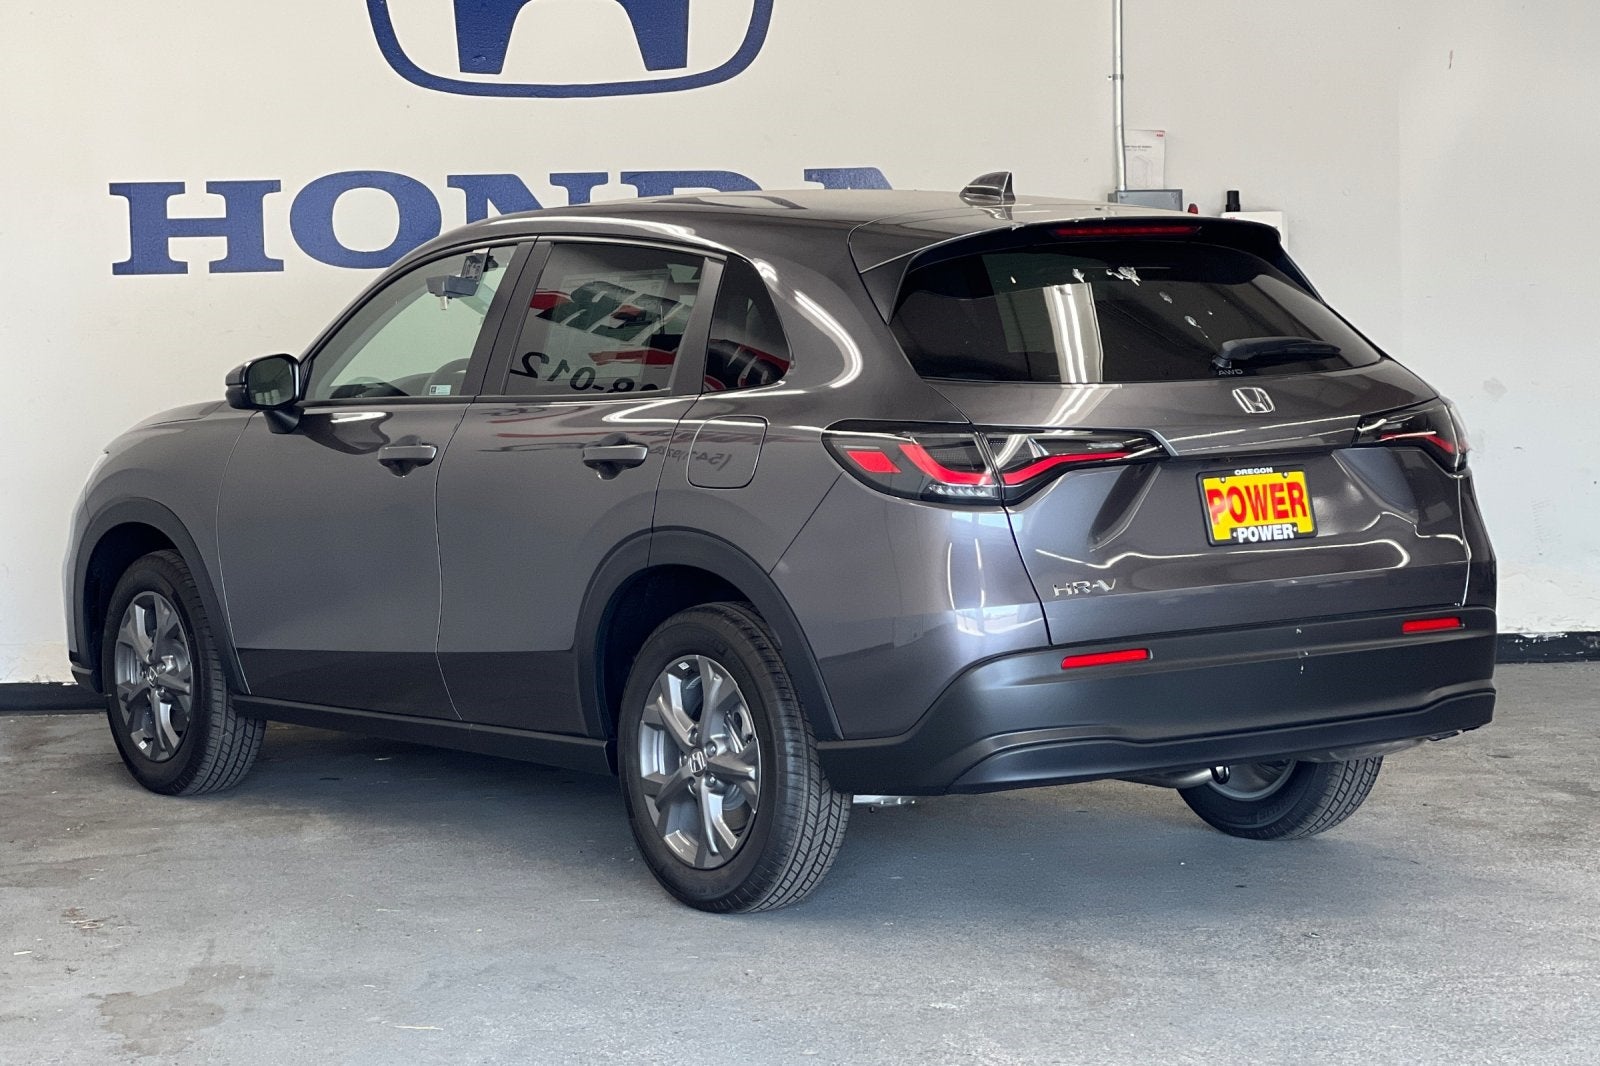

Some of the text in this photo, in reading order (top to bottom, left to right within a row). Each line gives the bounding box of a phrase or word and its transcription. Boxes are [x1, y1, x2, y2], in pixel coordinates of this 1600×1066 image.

[1234, 468, 1273, 476] OREGON
[1206, 482, 1307, 525] POWER
[1238, 525, 1295, 543] POWER
[1052, 578, 1117, 597] HR-V
